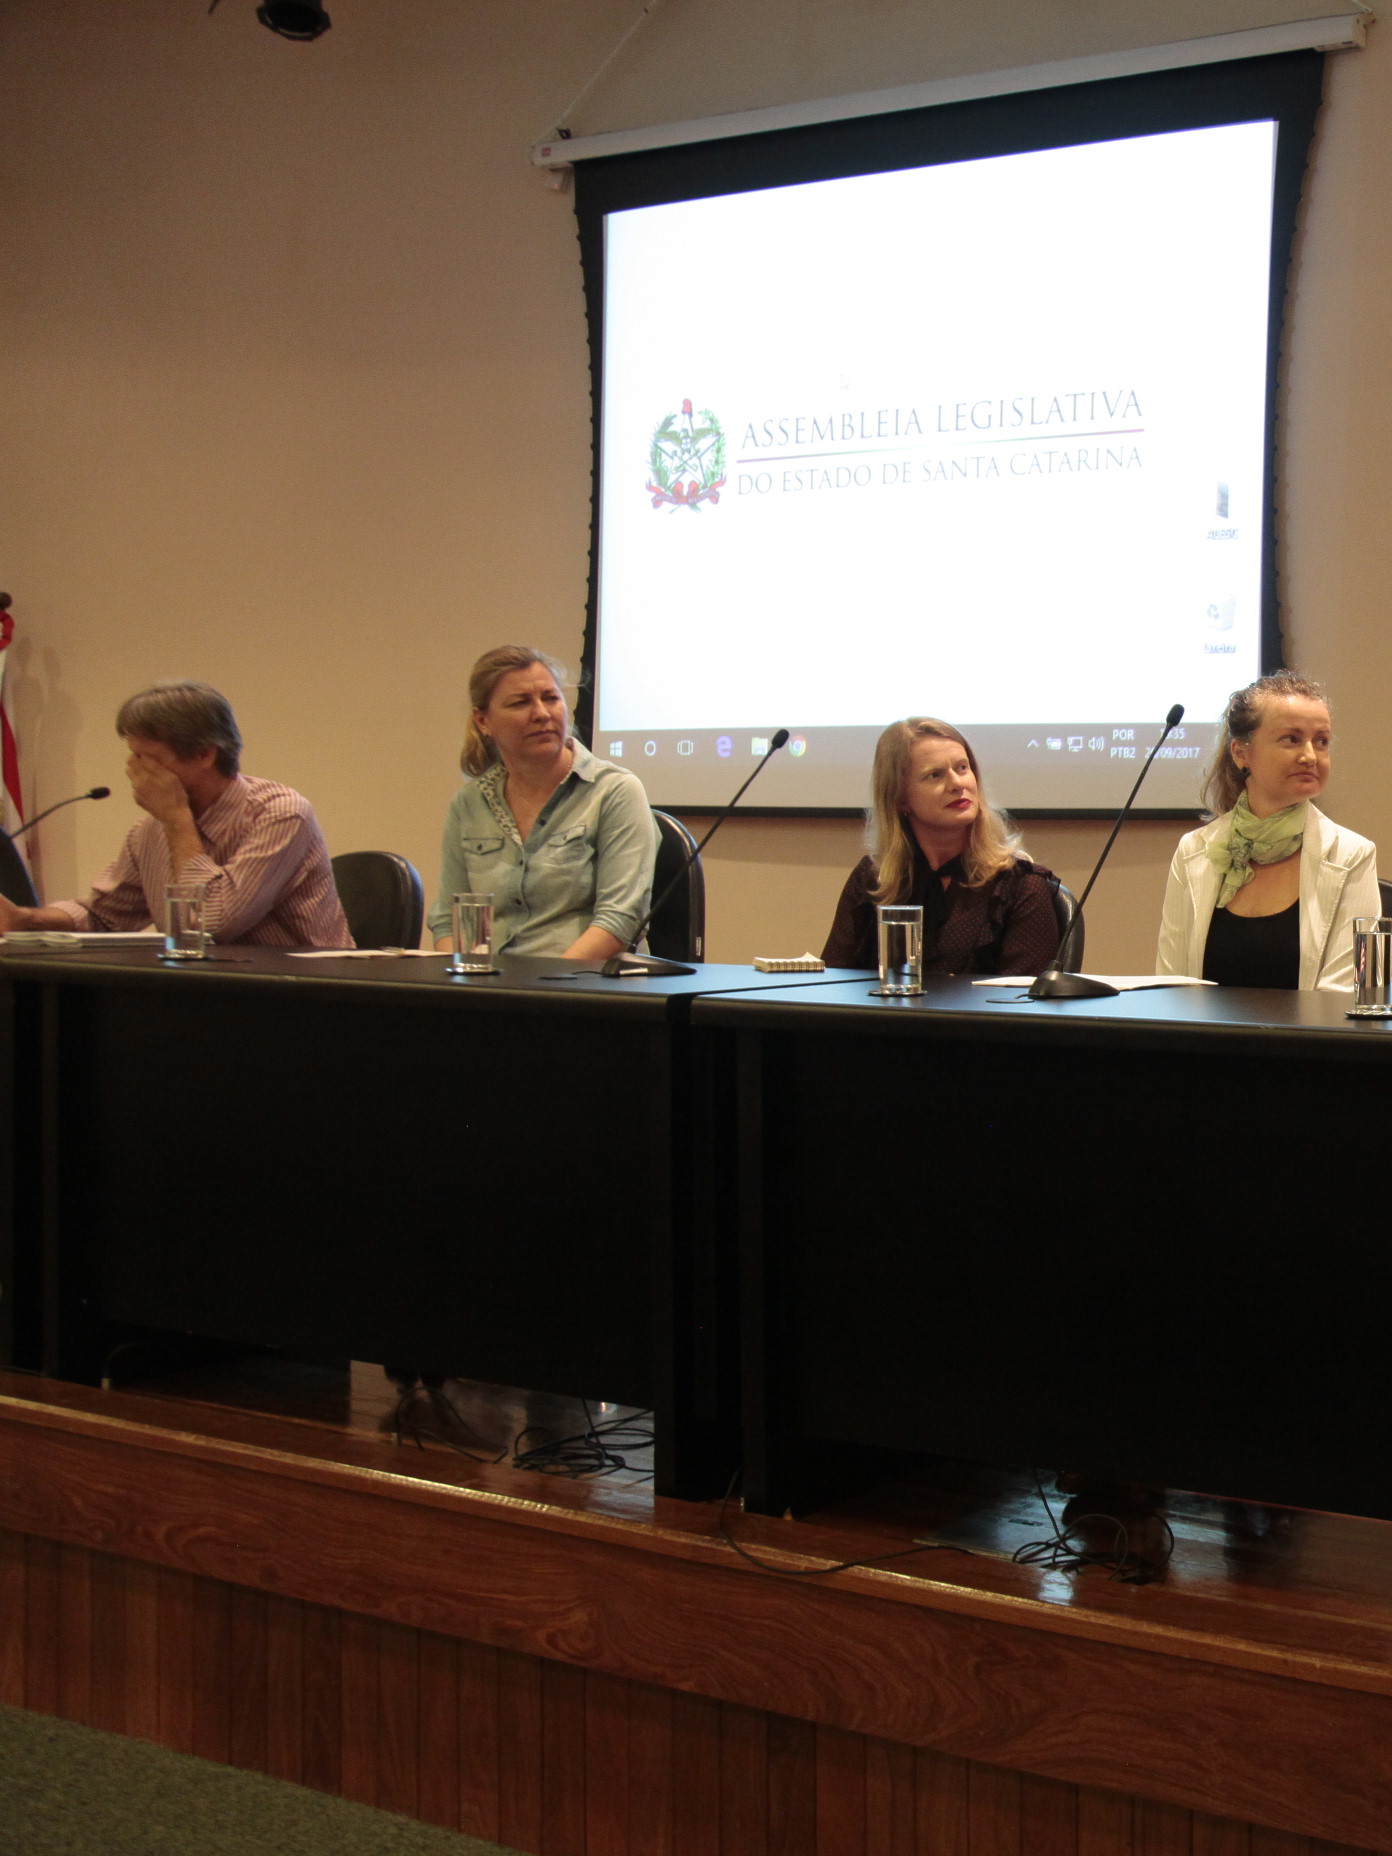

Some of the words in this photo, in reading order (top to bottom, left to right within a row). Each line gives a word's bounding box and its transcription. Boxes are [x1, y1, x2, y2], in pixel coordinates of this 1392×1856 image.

[741, 407, 923, 449] ASSEMBLEIA
[937, 389, 1143, 433] LEGISLATIVA
[738, 472, 773, 496] DO
[782, 465, 872, 493] ESTADO
[882, 461, 912, 486] DE
[921, 455, 1001, 482] SANTA
[1009, 446, 1143, 476] CATARINA
[1112, 728, 1135, 741] POR
